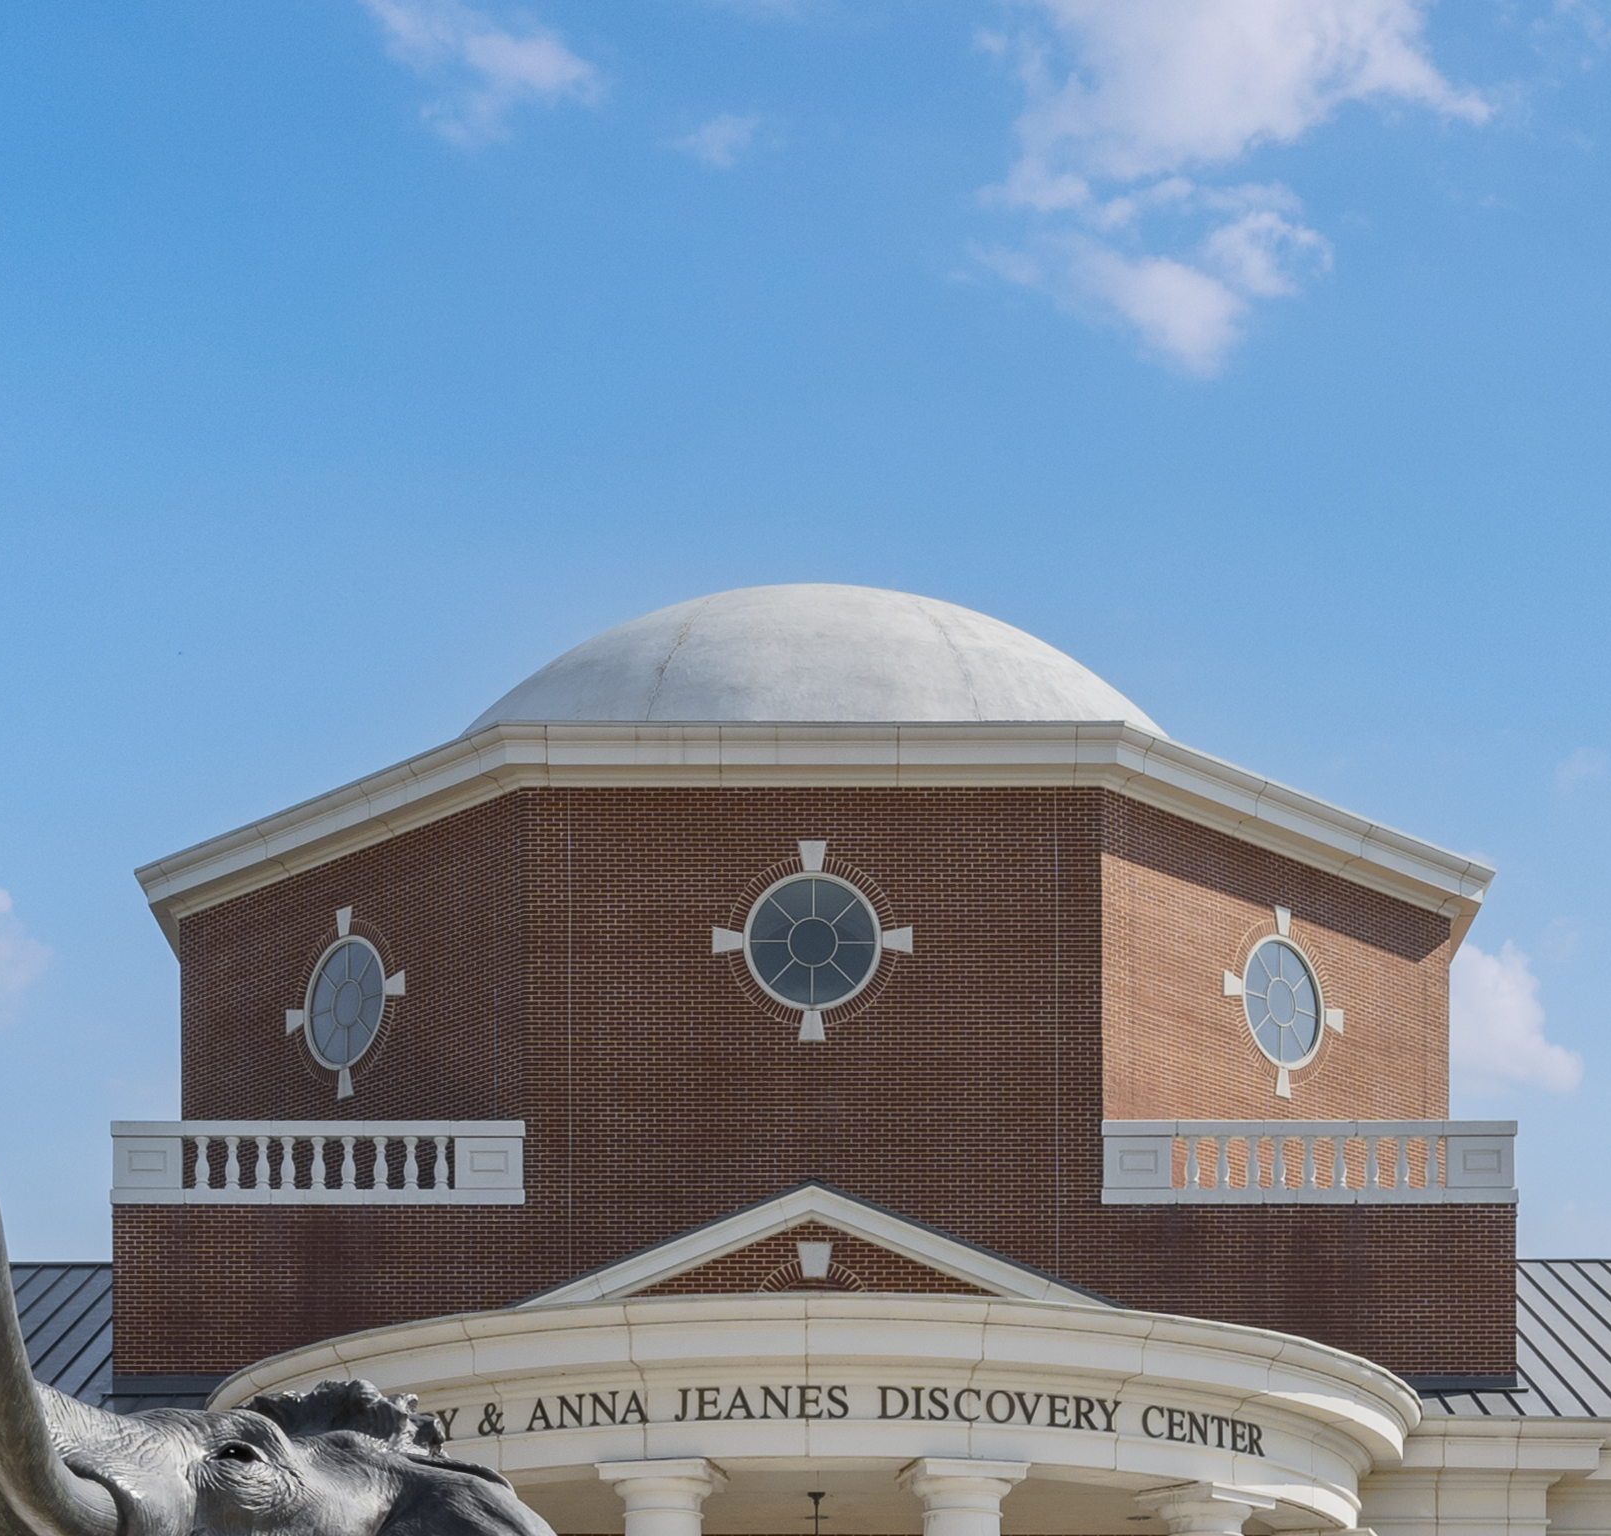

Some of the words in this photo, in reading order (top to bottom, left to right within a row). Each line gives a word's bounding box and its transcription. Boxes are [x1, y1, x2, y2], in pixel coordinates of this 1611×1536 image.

[477, 1402, 505, 1437] &
[526, 1390, 648, 1433] ANNA
[674, 1385, 850, 1423] JEANES
[877, 1385, 1122, 1433] DISCOVERY
[1142, 1405, 1266, 1457] CENTER
